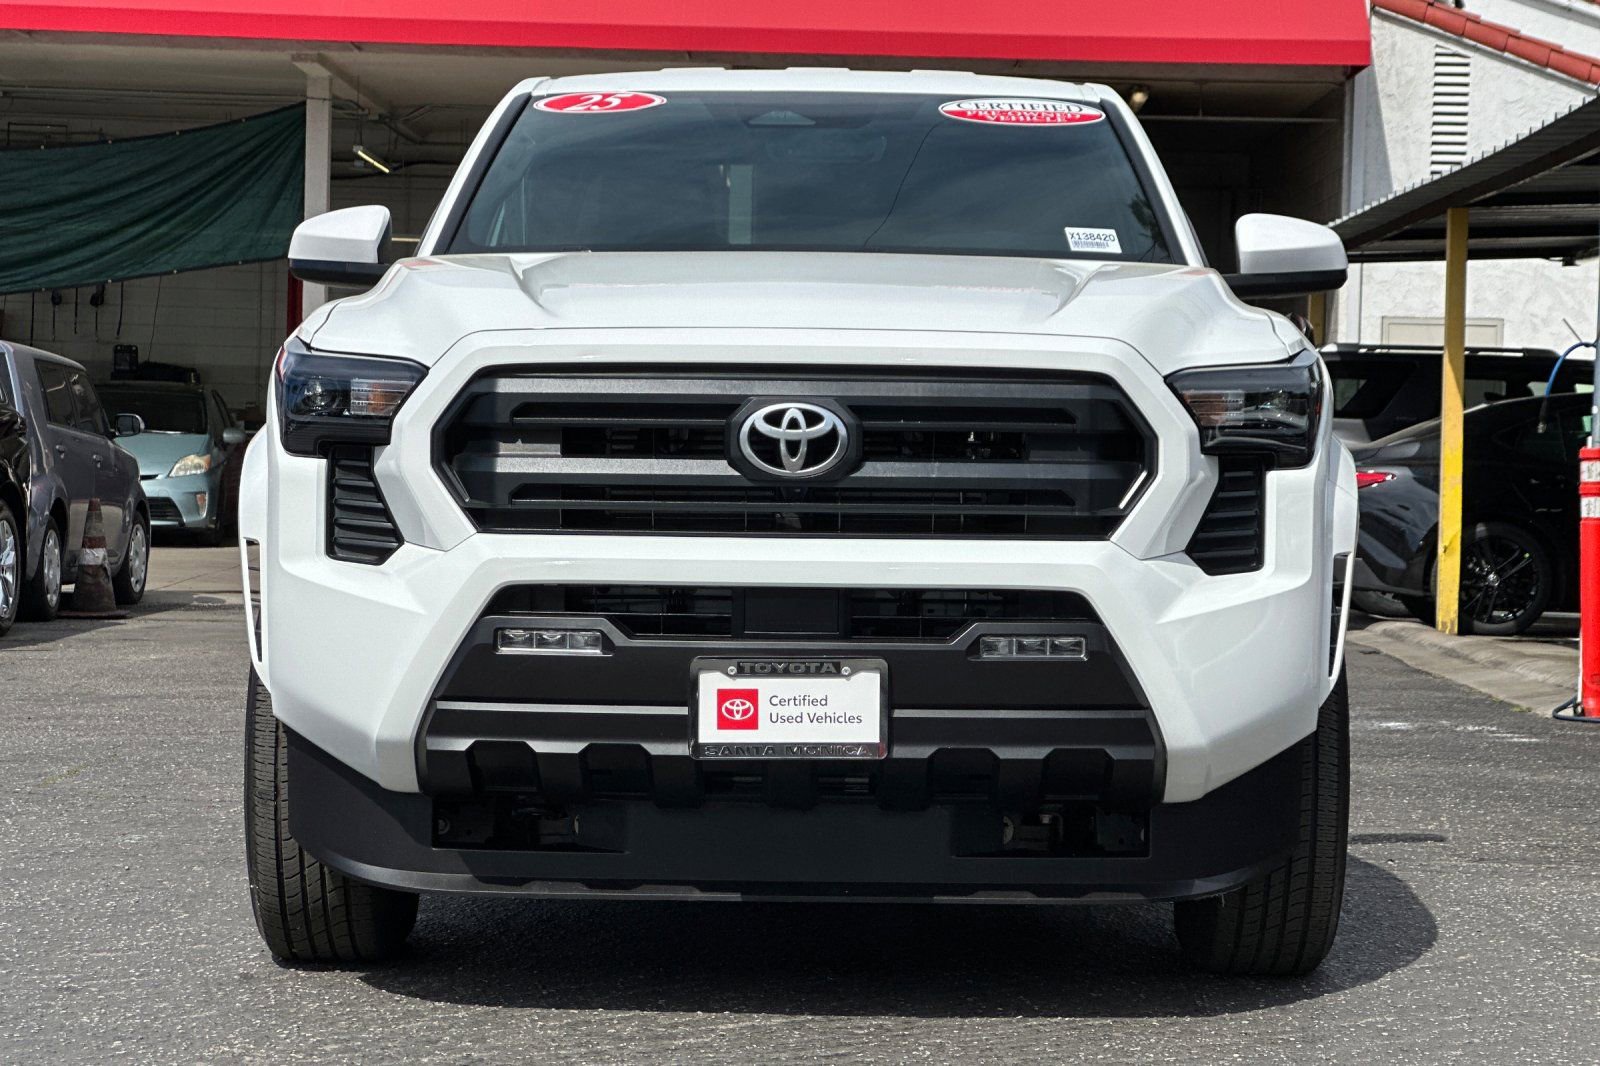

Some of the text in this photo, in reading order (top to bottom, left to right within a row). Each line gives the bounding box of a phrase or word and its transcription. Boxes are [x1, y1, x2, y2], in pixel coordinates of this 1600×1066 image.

[563, 93, 633, 111] 25
[957, 102, 1083, 113] CERTIFIED
[986, 115, 1067, 123] VEHICLE
[1069, 231, 1116, 242] X138420
[739, 662, 837, 674] TOYOTA
[769, 695, 828, 707] Certified
[769, 712, 863, 724] Used Vehicles
[705, 745, 872, 756] SANTA MONICA
